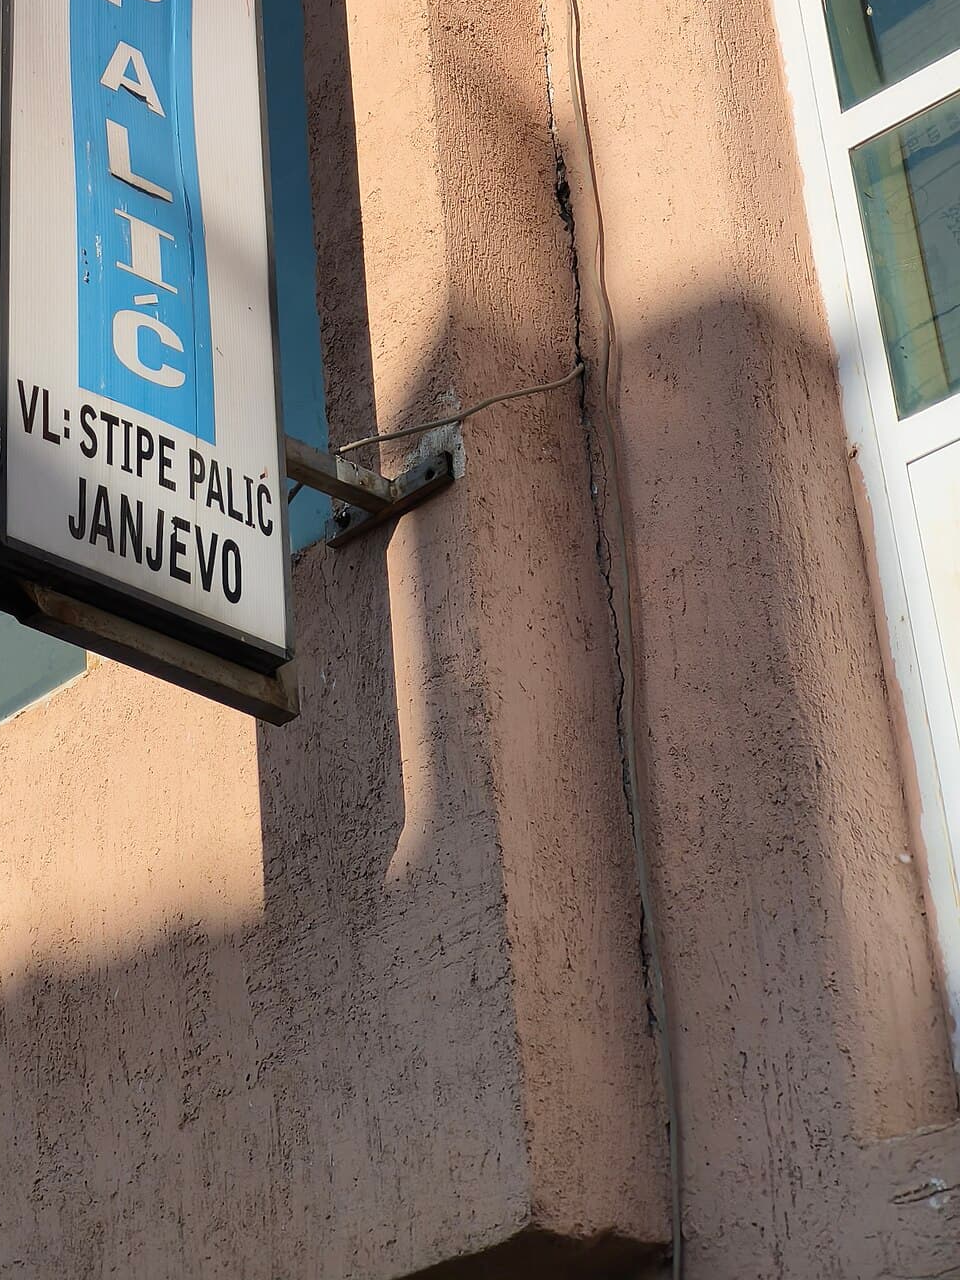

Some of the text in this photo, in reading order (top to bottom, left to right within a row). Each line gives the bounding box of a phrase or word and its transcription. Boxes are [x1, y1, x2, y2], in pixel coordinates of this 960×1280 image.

[16, 379, 274, 538] VL: STIPE PALIĆ
[68, 477, 243, 604] JANJEVO
